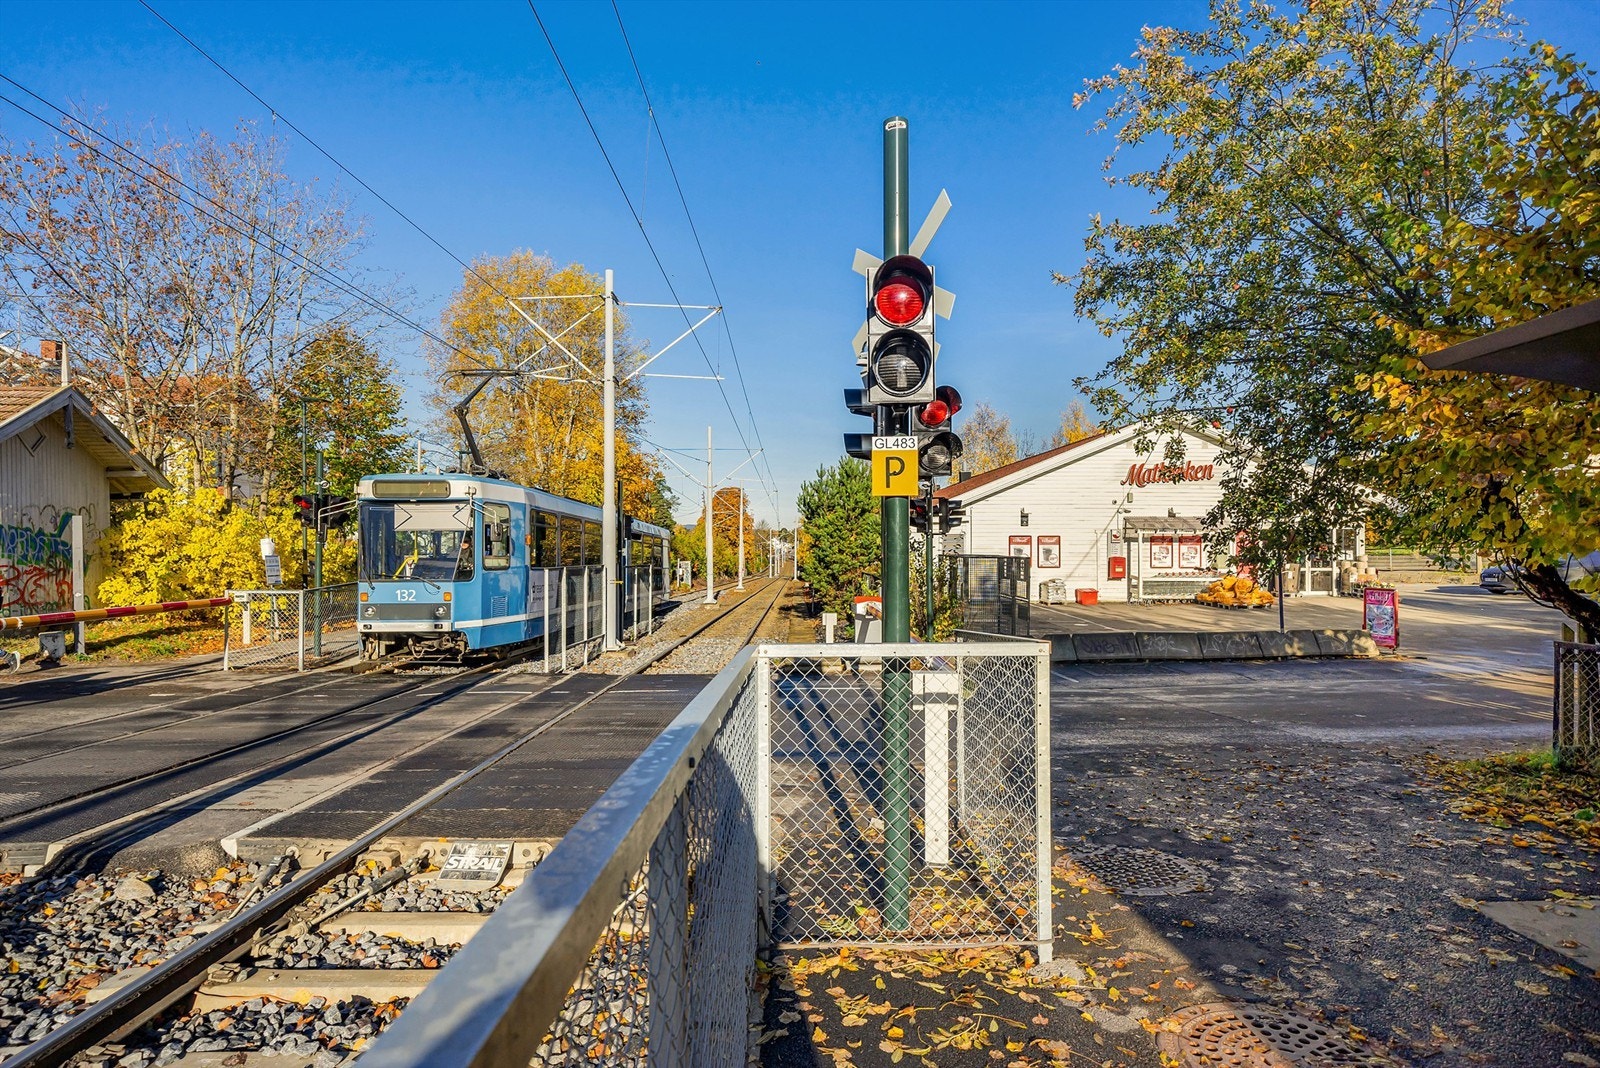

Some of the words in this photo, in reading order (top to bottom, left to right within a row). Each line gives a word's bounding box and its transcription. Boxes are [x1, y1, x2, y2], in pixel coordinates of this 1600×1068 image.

[874, 437, 916, 450] GL483
[885, 456, 906, 489] P
[395, 589, 416, 602] 132
